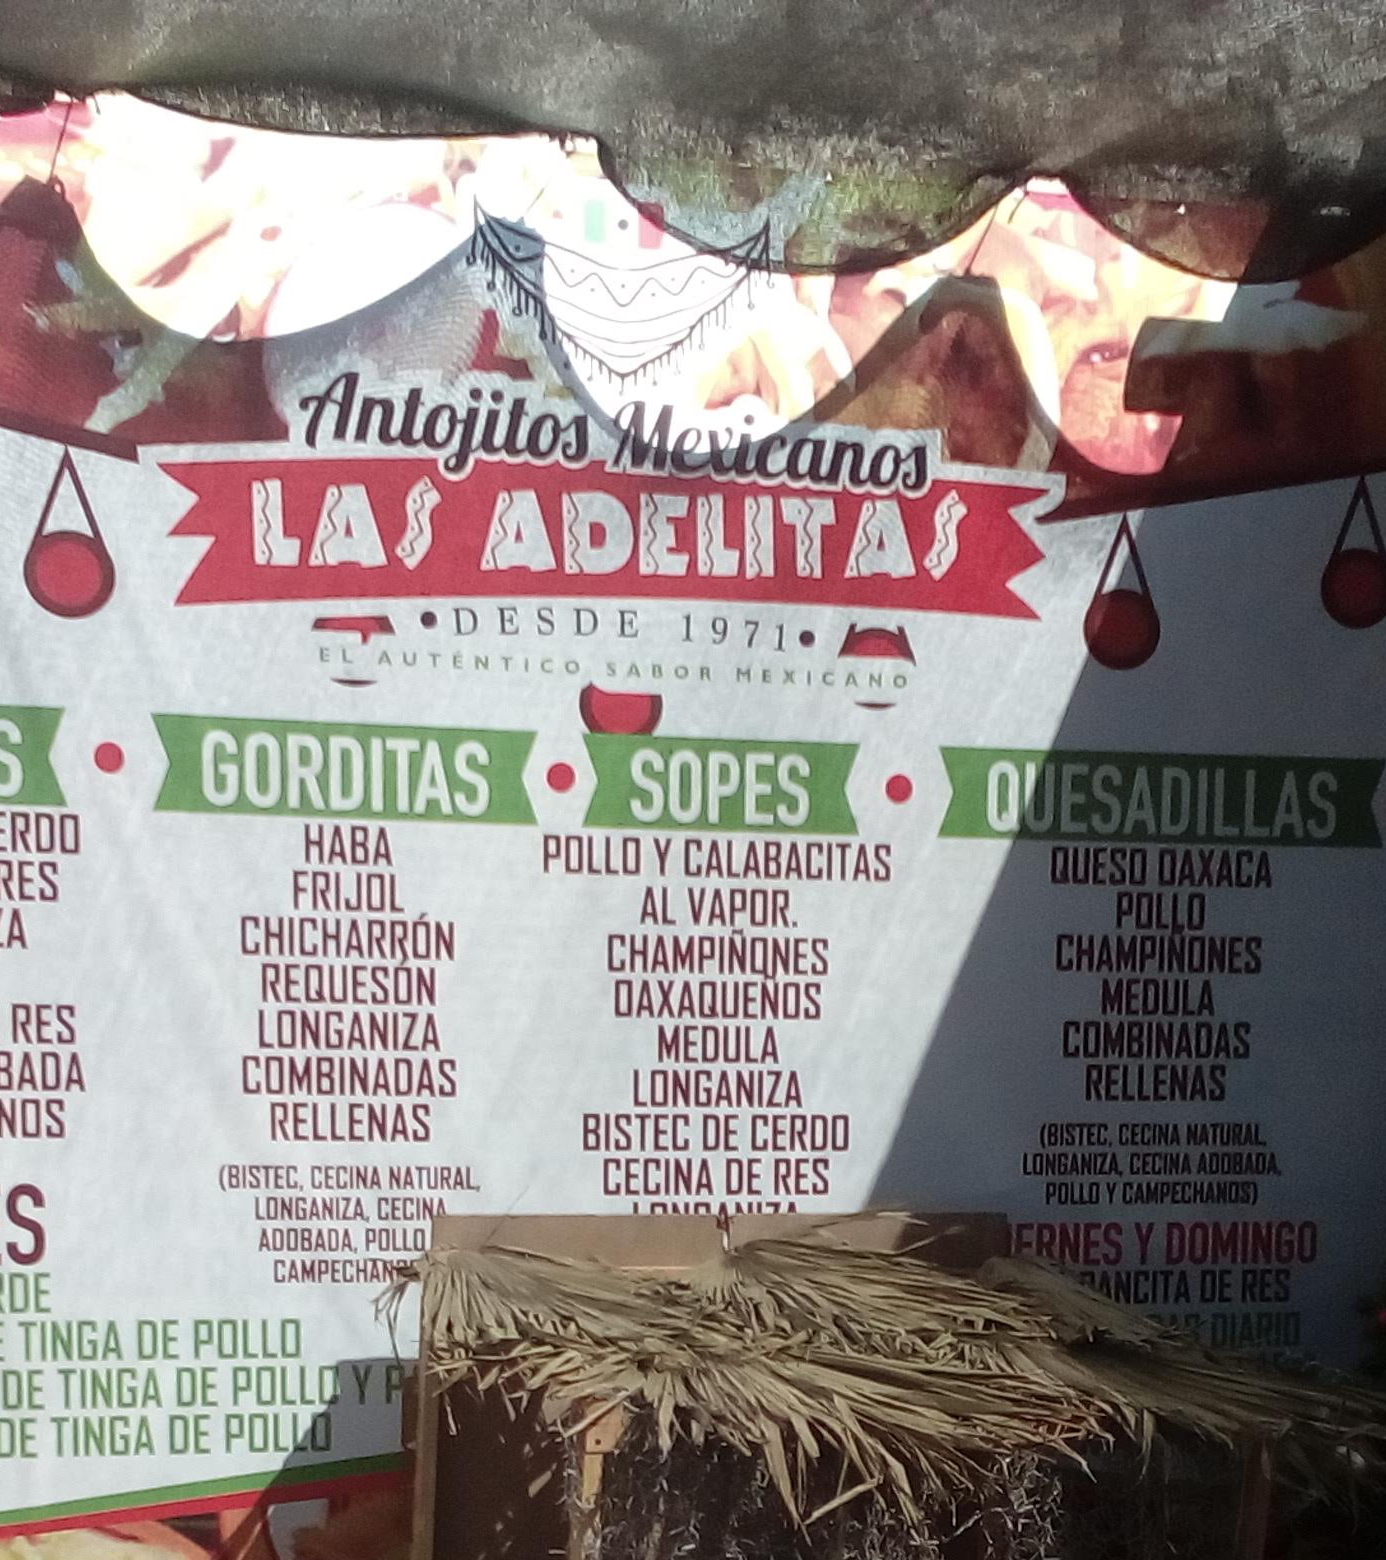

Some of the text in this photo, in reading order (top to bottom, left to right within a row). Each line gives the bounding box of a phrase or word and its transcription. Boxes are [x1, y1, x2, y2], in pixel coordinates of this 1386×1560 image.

[299, 372, 930, 494] Antojitos Mexicanos
[250, 475, 967, 582] LAS ADELITAS
[454, 606, 787, 653] DESDE 1971
[318, 647, 910, 690] EL AUTÉNTICO SABOR MEXICANO
[201, 729, 491, 817] GORDITAS
[629, 748, 811, 827] SOPES
[985, 759, 1338, 839] QUESADILLAS
[303, 823, 394, 867] HABA
[542, 835, 893, 882] POLLO Y CALABACITAS
[1049, 846, 1273, 889] QUESO OAXACA
[292, 869, 405, 914] FRIJOL
[639, 887, 798, 929] AL VAPOR.
[1115, 890, 1206, 931] POLLO
[240, 912, 456, 961] CHICHARRÓN
[606, 930, 830, 978] CHAMPIÑONES
[1055, 928, 1263, 975] CHAMPIÑONES
[261, 954, 438, 1007] REQUESÓN
[613, 974, 822, 1021] OAXAQUEÑOS
[1100, 977, 1216, 1018] MEDULA
[11, 1003, 77, 1045] RES
[257, 1009, 441, 1052] LONGANIZA
[657, 1025, 780, 1064] MEDULA
[1062, 1020, 1251, 1060] COMBINADAS
[241, 1055, 457, 1097] COMBINADAS
[632, 1069, 803, 1109] LONGANIZA
[1085, 1062, 1227, 1102] RELLENAS
[270, 1101, 432, 1143] RELLENAS
[582, 1113, 850, 1153] BISTEC DE CERDO
[1039, 1122, 1112, 1149] (BISTEC,
[1118, 1122, 1180, 1146] CECINA
[218, 1164, 481, 1193] (BISTEC, CECINA NATURAL,
[602, 1157, 830, 1196] CECINA DE RES
[1021, 1152, 1282, 1178] LONGANIZA, CECINA ADOBADA,
[254, 1196, 370, 1223] LONGANIZA,
[1045, 1181, 1259, 1206] POLLO Y CAMPECHANOS)
[258, 1227, 427, 1254] ADOBADA, POLLO
[1009, 1220, 1318, 1266] ERNES Y DOMINGO
[1199, 1269, 1233, 1303] DE
[1240, 1268, 1292, 1303] RES
[15, 1318, 125, 1362] TINGA
[136, 1318, 181, 1360] DE
[192, 1317, 303, 1360] POLLO
[1, 1368, 46, 1412] DE
[58, 1366, 164, 1410] TINGA
[174, 1366, 219, 1408] DE
[231, 1364, 340, 1408] POLLO
[353, 1364, 376, 1405] Y
[50, 1415, 156, 1459] TINGA
[168, 1413, 212, 1456] DE
[225, 1411, 333, 1454] POLLO
